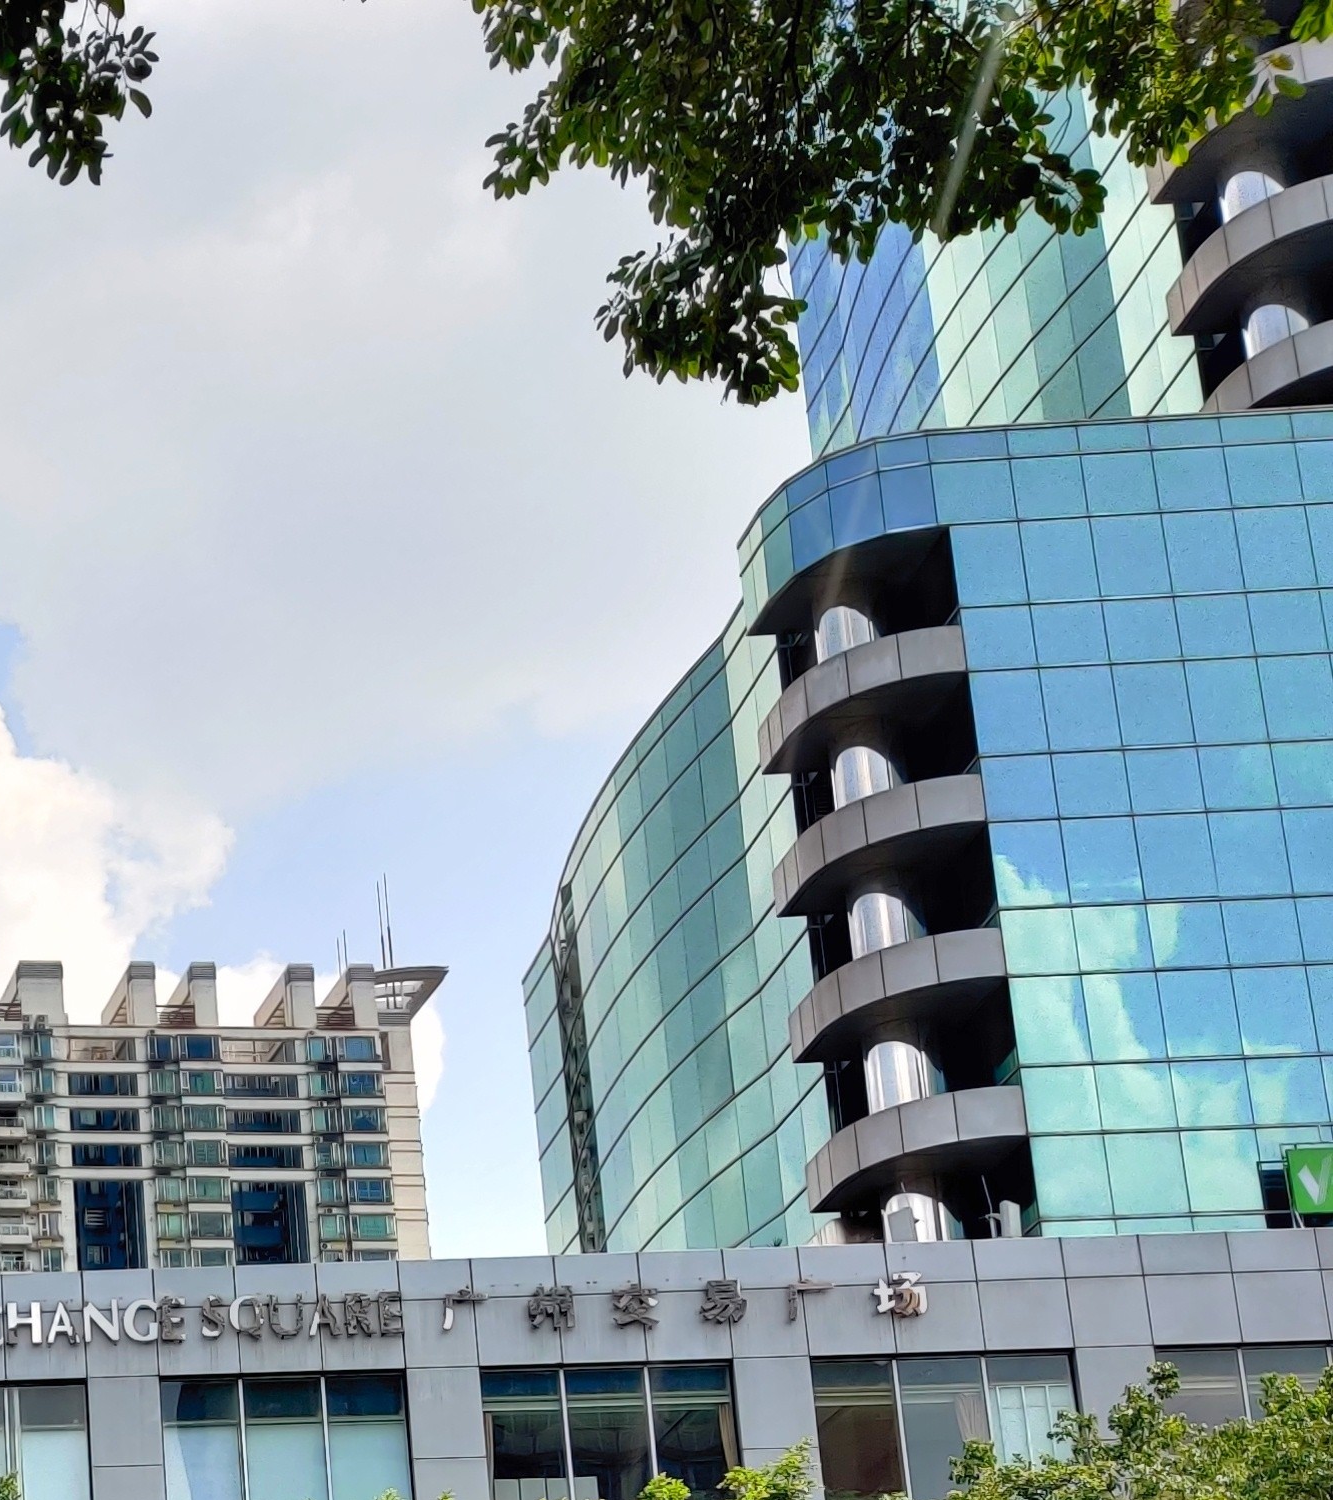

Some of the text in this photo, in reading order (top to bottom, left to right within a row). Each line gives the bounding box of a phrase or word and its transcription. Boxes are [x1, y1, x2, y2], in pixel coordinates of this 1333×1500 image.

[200, 1290, 404, 1341] SQUARE
[442, 1272, 929, 1333] 广州交易广场
